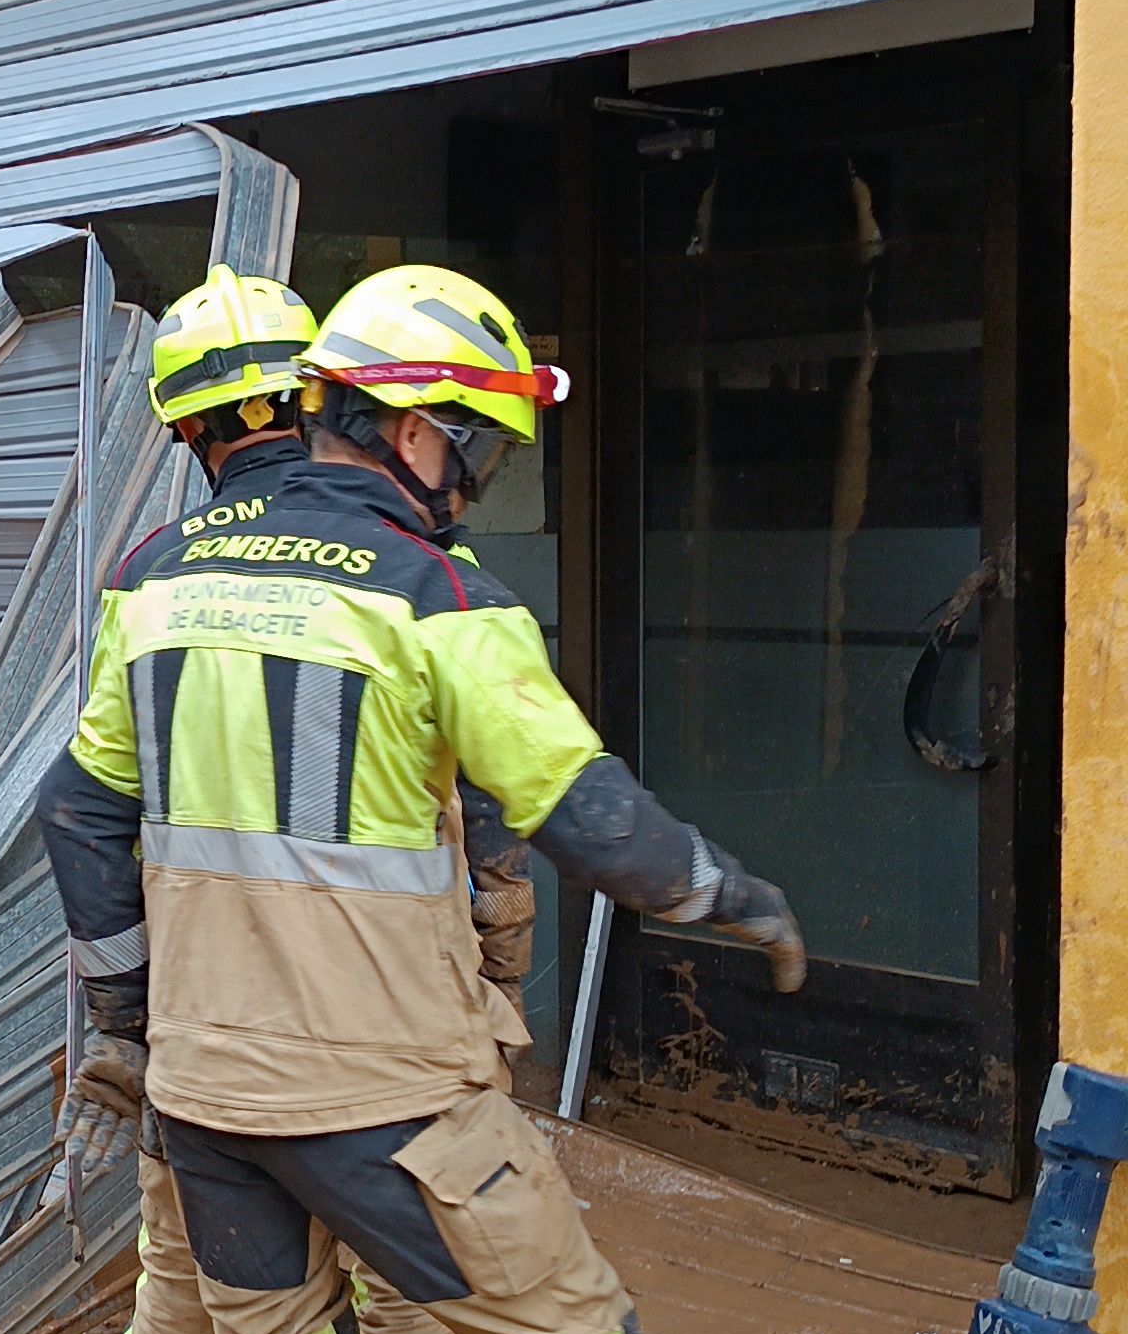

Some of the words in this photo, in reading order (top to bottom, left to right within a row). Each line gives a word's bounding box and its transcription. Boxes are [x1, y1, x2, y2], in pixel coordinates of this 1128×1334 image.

[181, 496, 273, 537] BOM
[180, 535, 377, 575] BOMBEROS
[191, 608, 308, 636] ALBACETE
